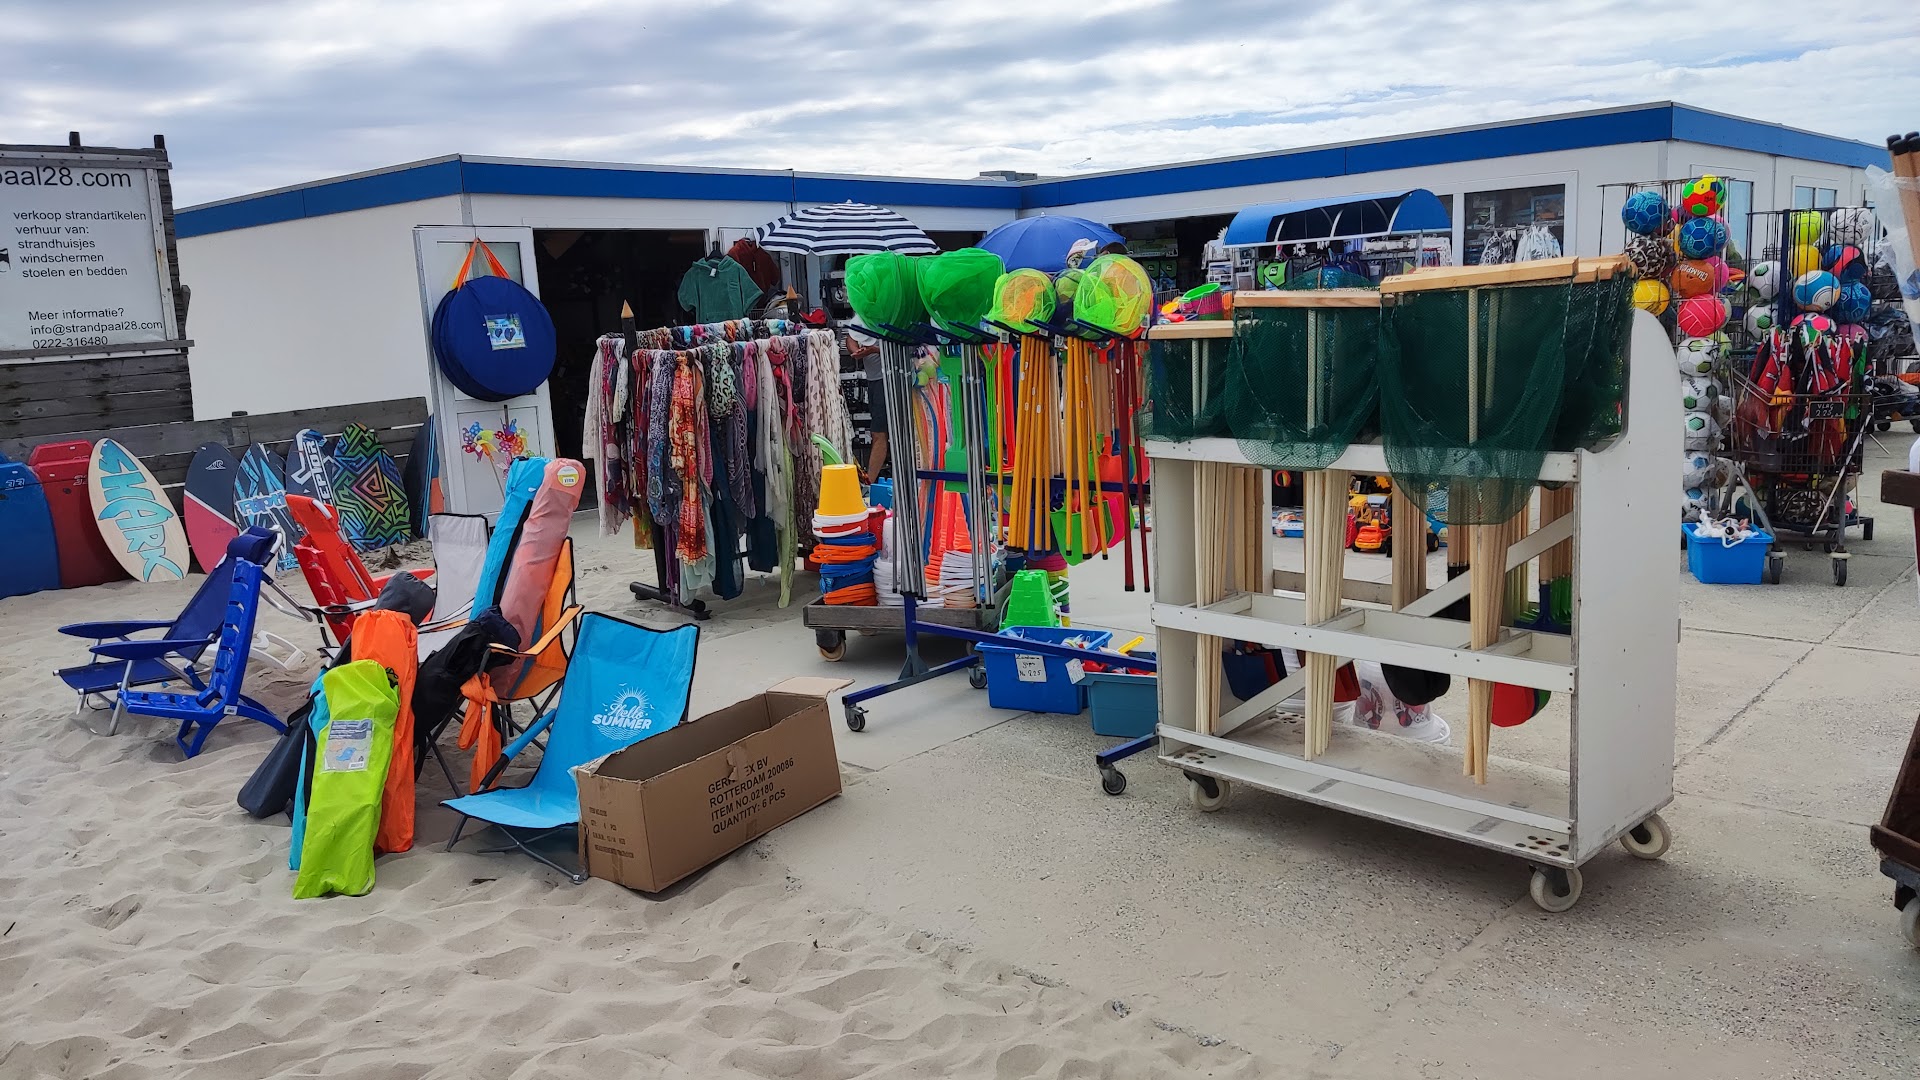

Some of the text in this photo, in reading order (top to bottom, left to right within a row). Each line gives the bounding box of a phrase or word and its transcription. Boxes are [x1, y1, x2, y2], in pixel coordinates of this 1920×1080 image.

[0, 166, 131, 188] aal28.com
[13, 211, 147, 222] verkoop strandartikelen
[15, 225, 91, 235] verhuur van:
[18, 239, 96, 251] strandhuisjes
[19, 253, 104, 263] windschermen
[22, 266, 128, 278] stoelen en bedden
[28, 307, 124, 321] Meer informatie?
[30, 320, 163, 336] info@strandpaal28.com
[32, 336, 108, 349] 0222-316480
[98, 439, 184, 582] SHARK
[607, 703, 644, 719] Hello
[591, 713, 652, 730] SUMMER
[756, 756, 768, 770] BV
[709, 772, 766, 808] ROTTERDAM
[711, 782, 774, 821] ITEM NO.02180
[712, 788, 786, 834] QUANTITY: 6 PCS
